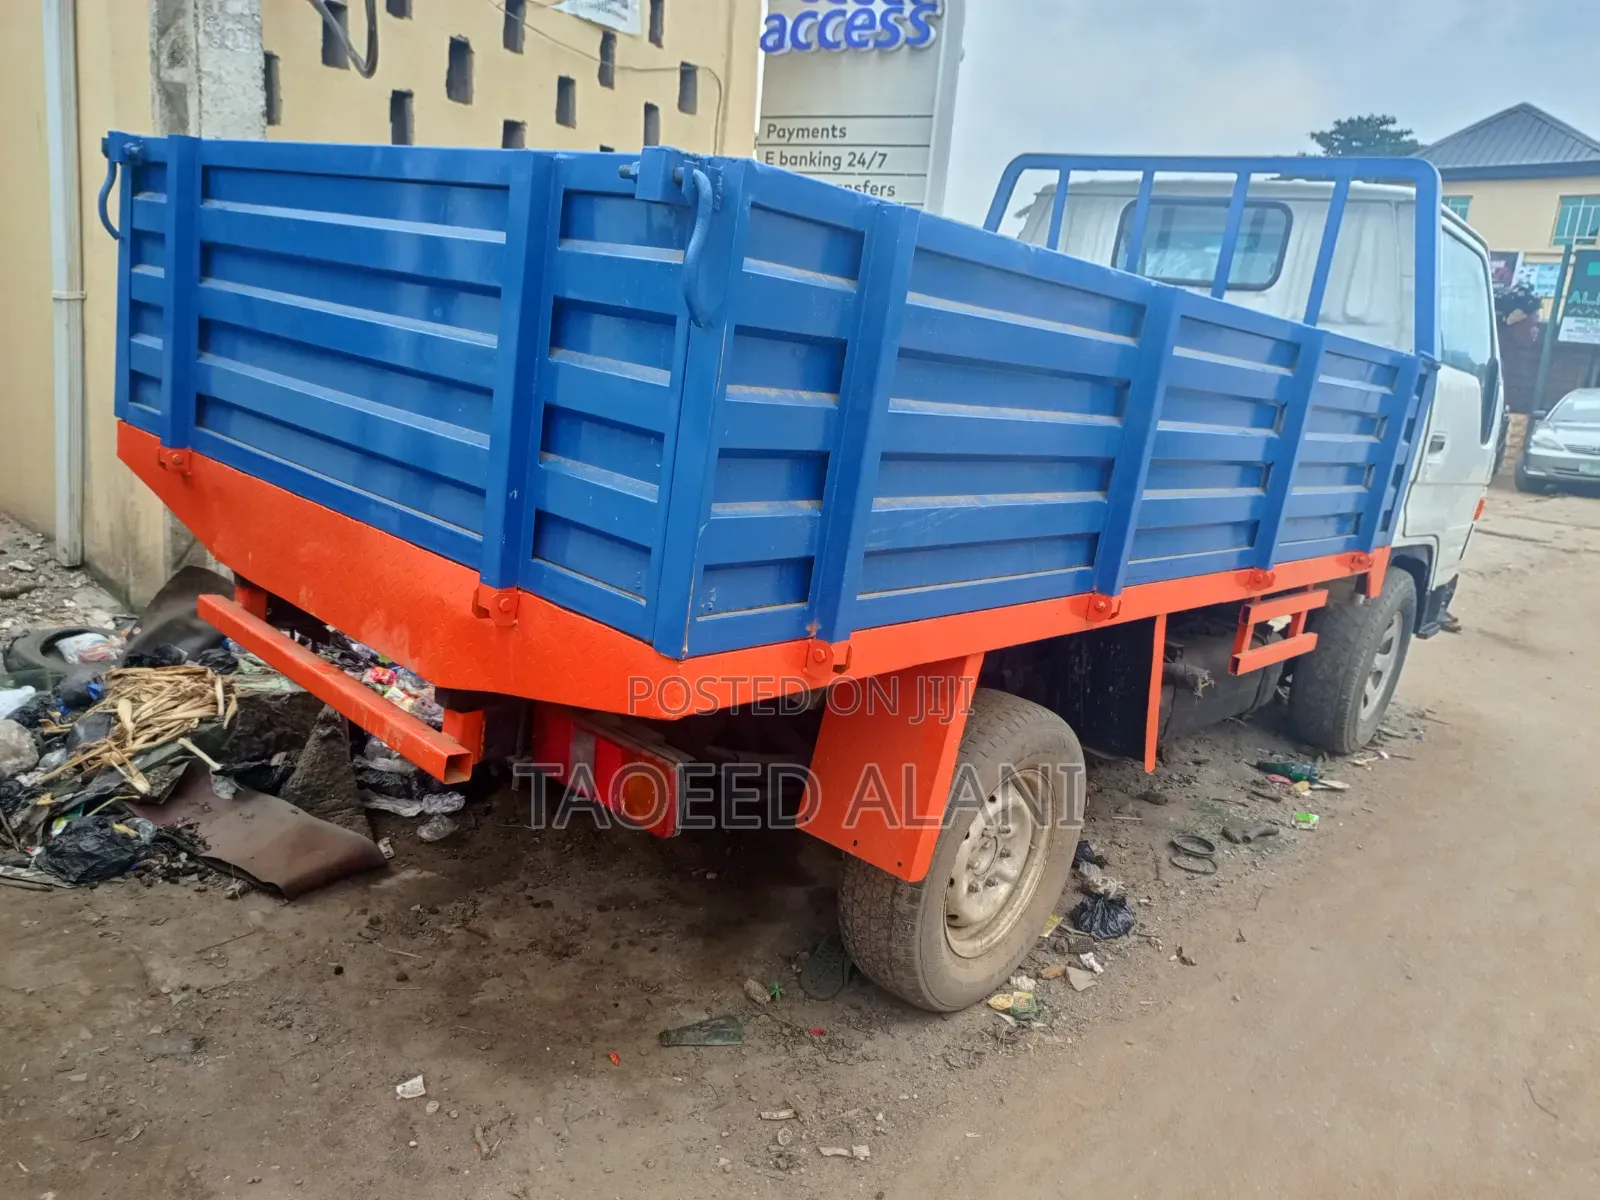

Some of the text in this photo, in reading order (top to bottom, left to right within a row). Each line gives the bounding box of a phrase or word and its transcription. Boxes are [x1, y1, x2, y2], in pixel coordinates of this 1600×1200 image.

[760, 4, 939, 53] access
[766, 123, 847, 143] Payments
[765, 151, 888, 171] E banking 24/7
